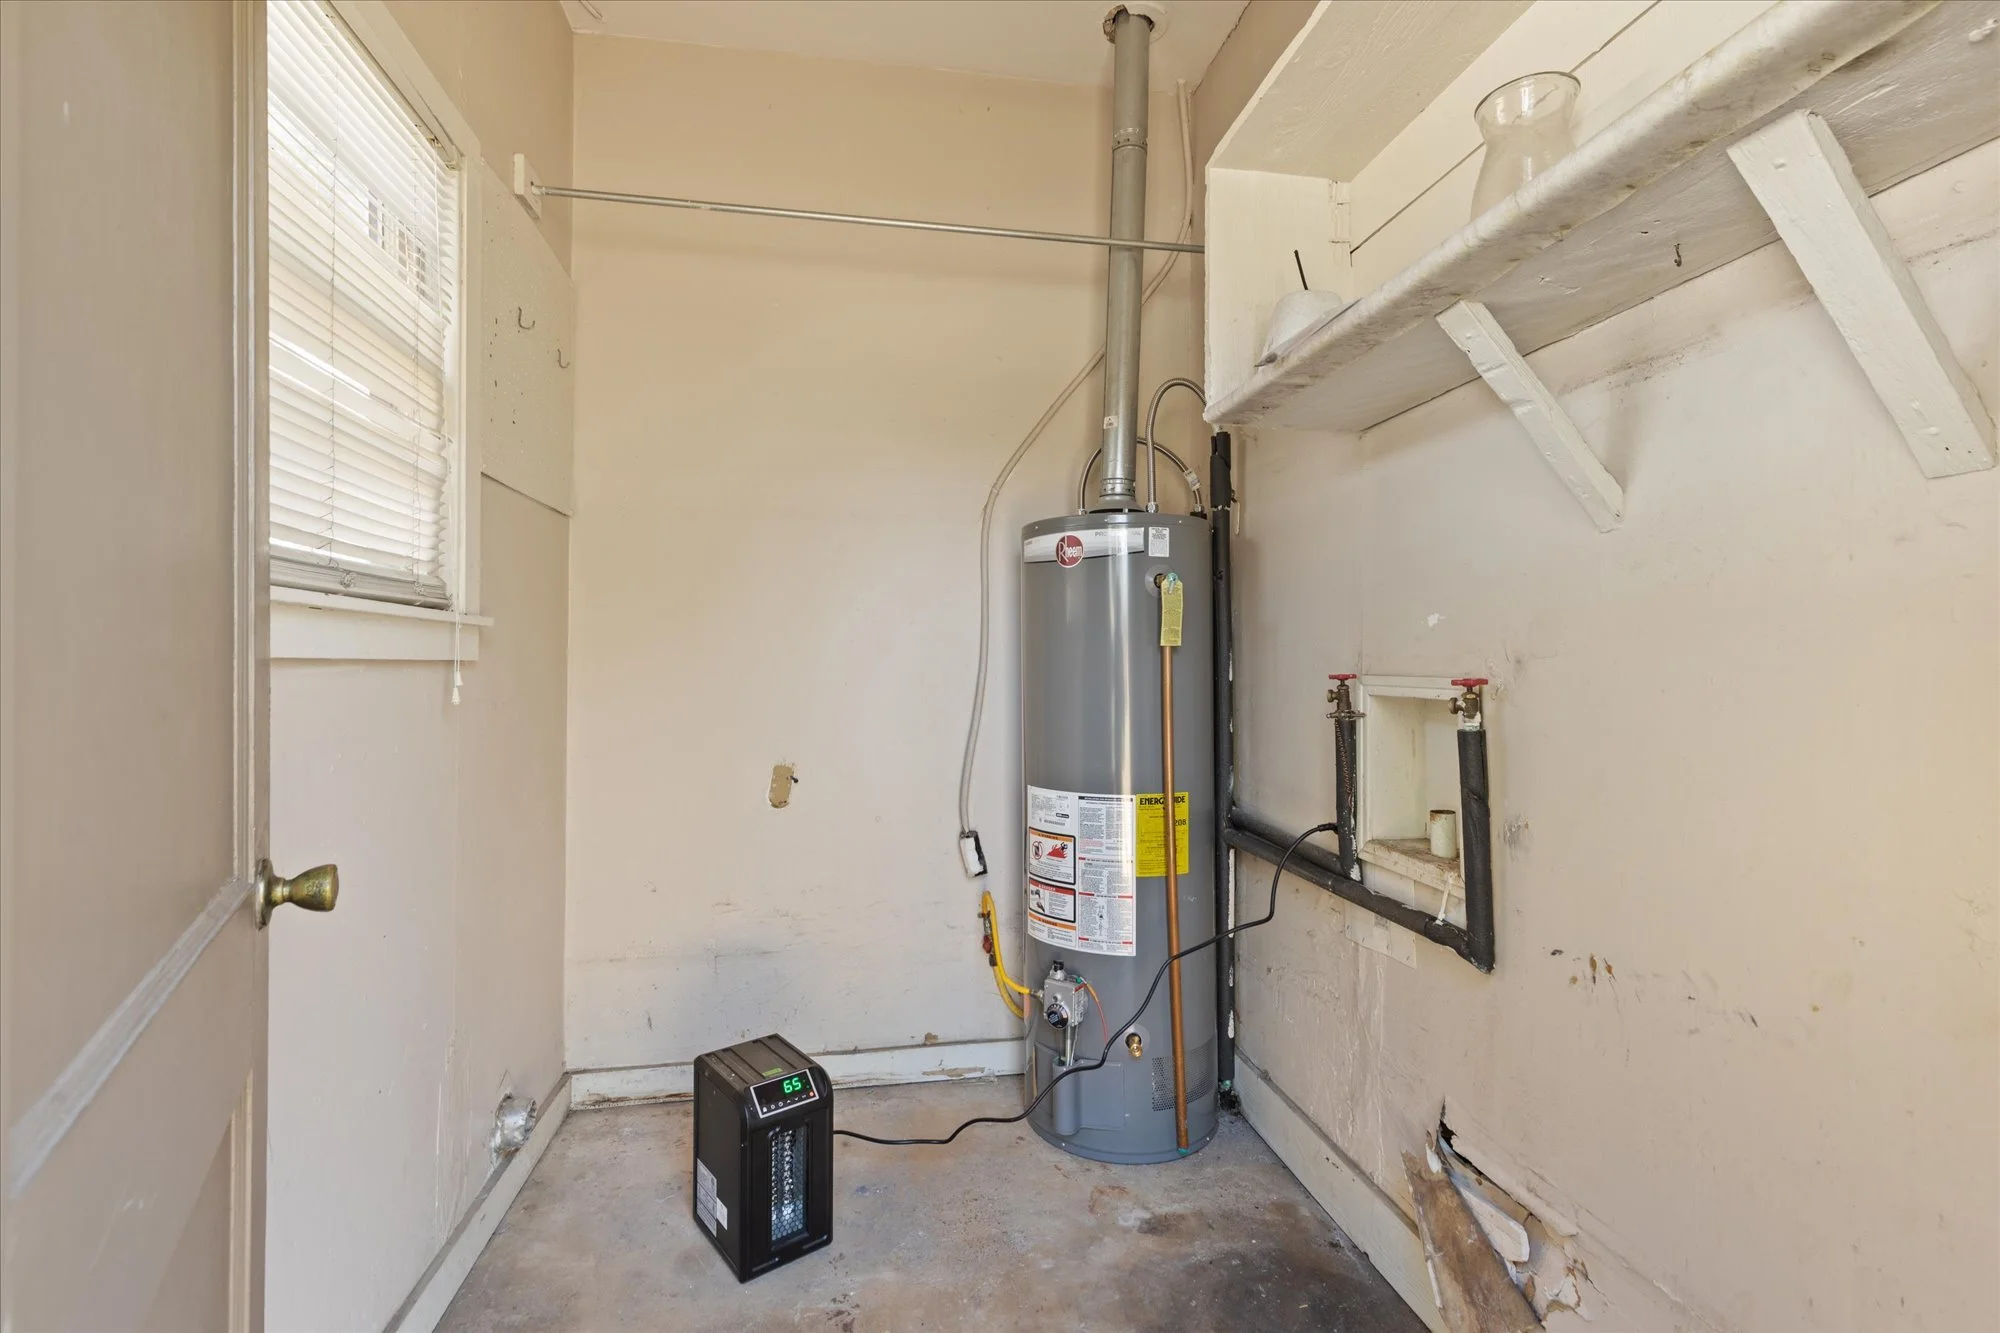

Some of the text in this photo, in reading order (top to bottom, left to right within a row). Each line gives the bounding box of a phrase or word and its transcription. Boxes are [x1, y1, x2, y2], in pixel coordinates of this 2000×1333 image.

[1059, 536, 1082, 562] Rheem
[1140, 796, 1186, 805] ENERGIDE
[784, 1077, 801, 1093] 65
